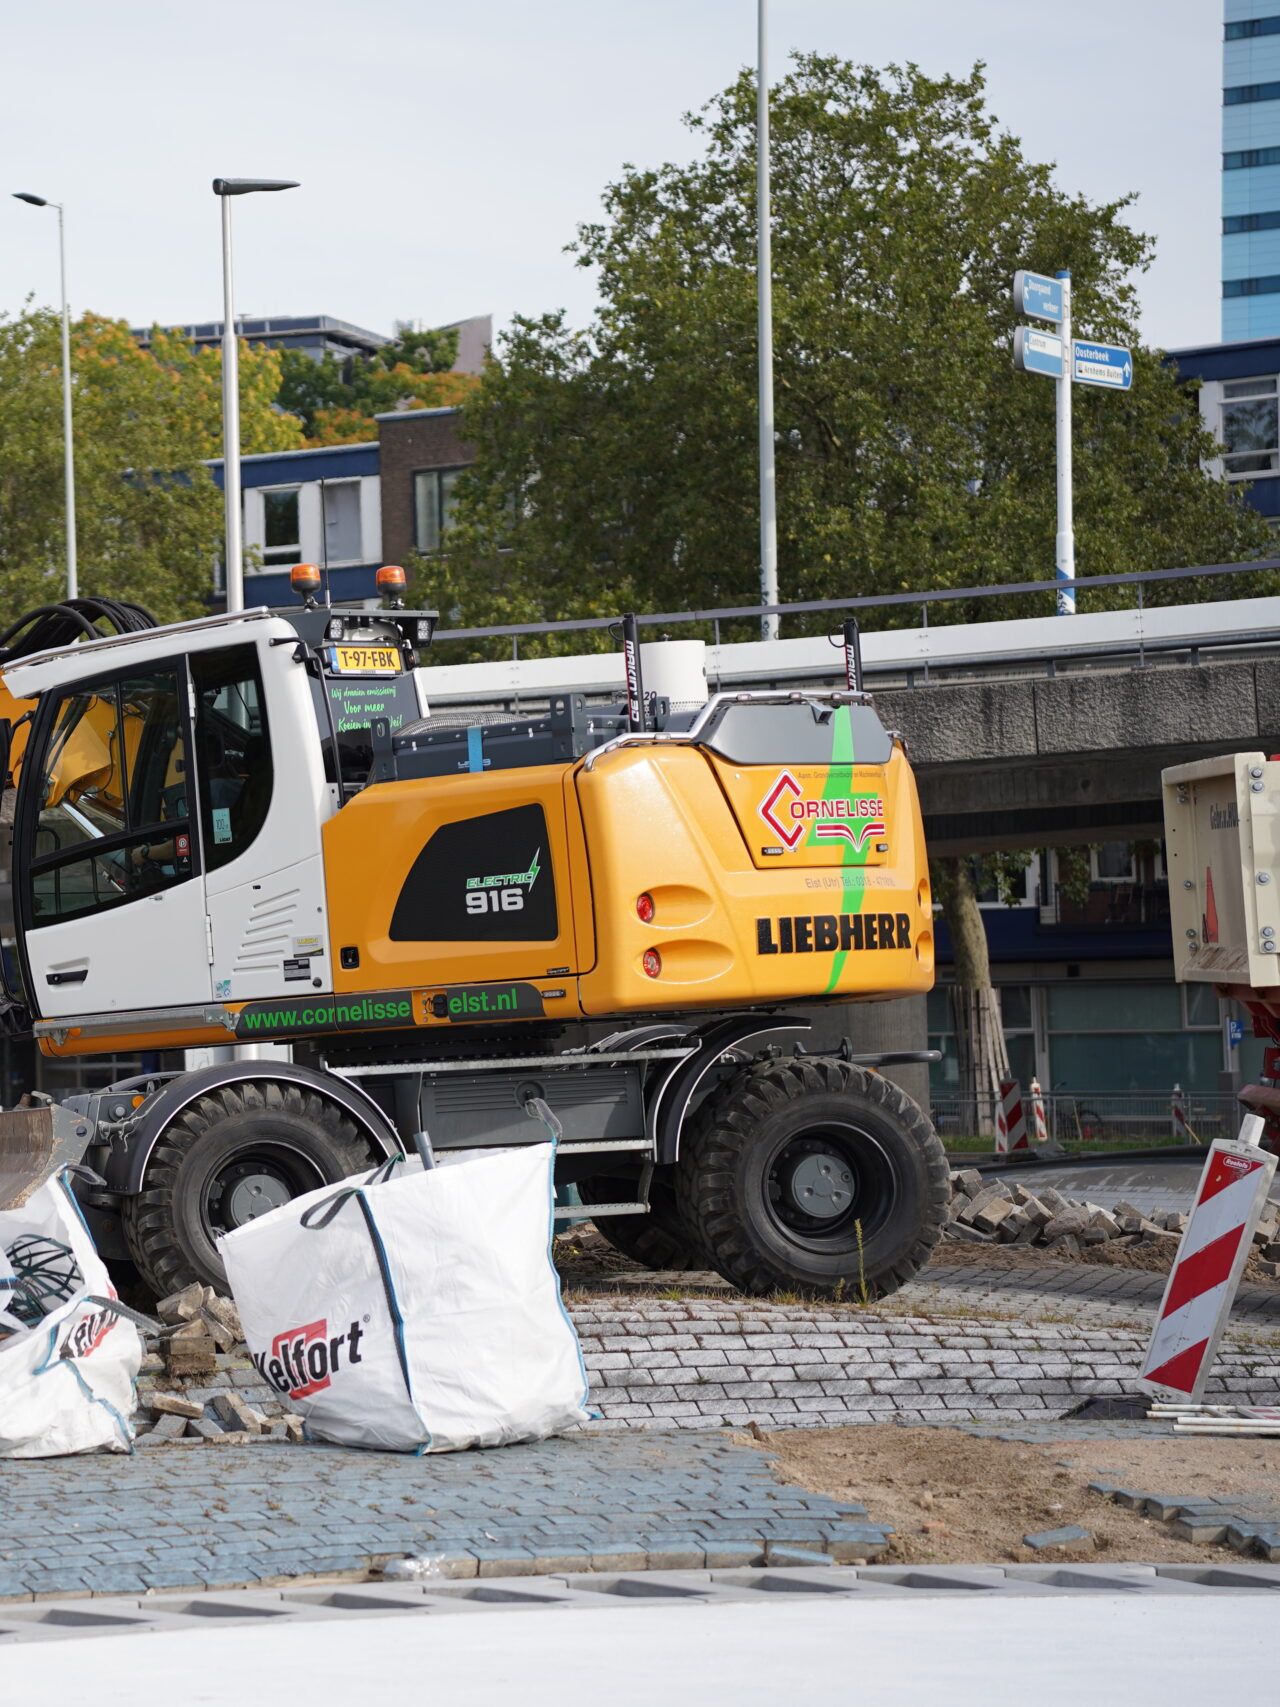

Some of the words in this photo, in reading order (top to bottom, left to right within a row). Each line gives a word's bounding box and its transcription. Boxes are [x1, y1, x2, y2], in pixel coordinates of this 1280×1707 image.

[1075, 346, 1110, 362] Oosterbeek
[341, 651, 395, 667] T-97-FBK
[343, 701, 361, 715] Voor
[364, 702, 385, 713] meer
[338, 717, 362, 733] Koeien
[757, 769, 884, 852] CORNELISSE
[466, 872, 536, 889] ELECTRIC
[465, 888, 524, 915] 916
[756, 912, 912, 955] LIEBHERR
[245, 999, 411, 1029] www.cornelisse
[449, 988, 518, 1014] elst.nl
[253, 1320, 364, 1393] Kelfort
